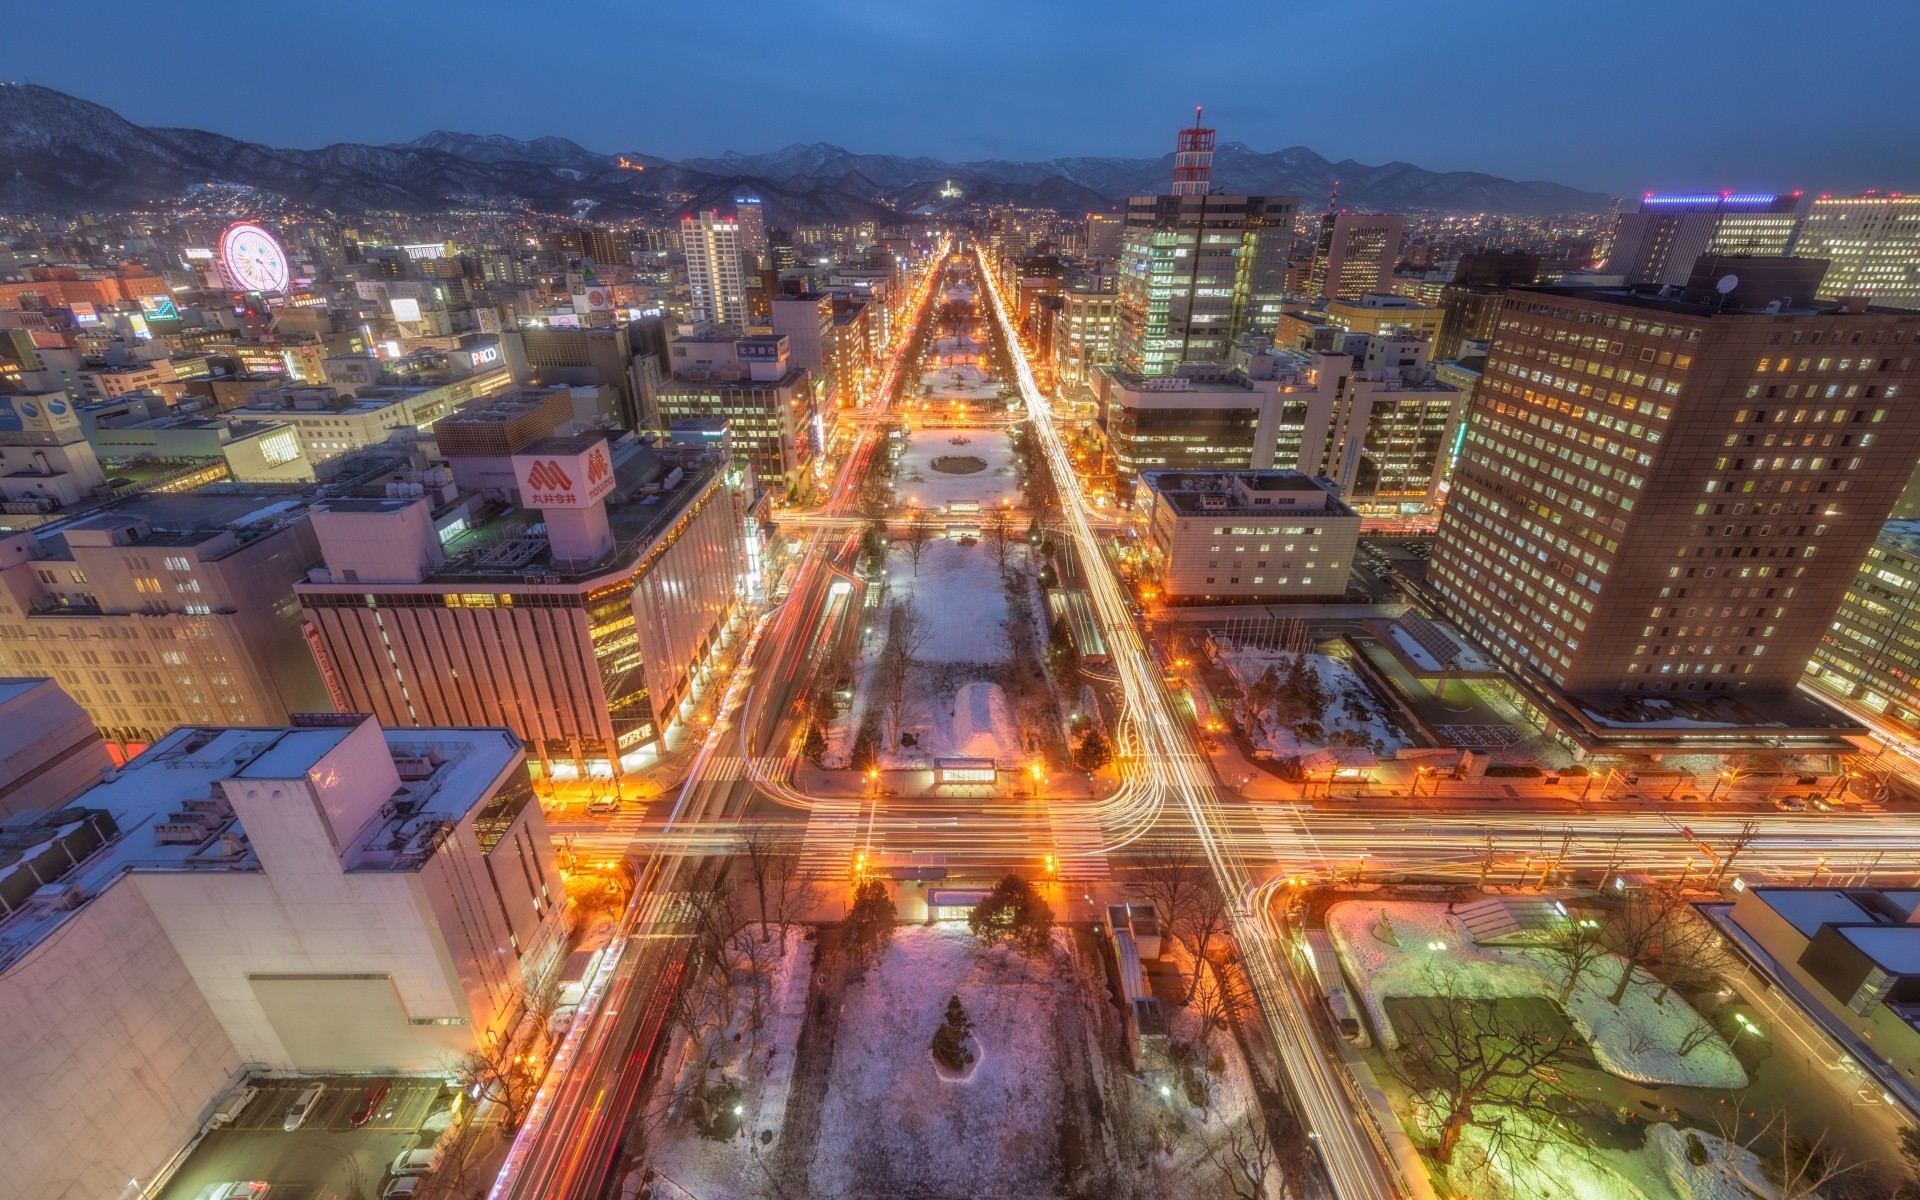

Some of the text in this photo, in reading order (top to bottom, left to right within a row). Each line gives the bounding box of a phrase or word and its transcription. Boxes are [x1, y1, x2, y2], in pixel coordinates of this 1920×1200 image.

[739, 346, 775, 355] 北洋銀行
[471, 347, 497, 366] PARCO
[330, 373, 368, 384] PARCO
[532, 493, 577, 504] 丸井今井
